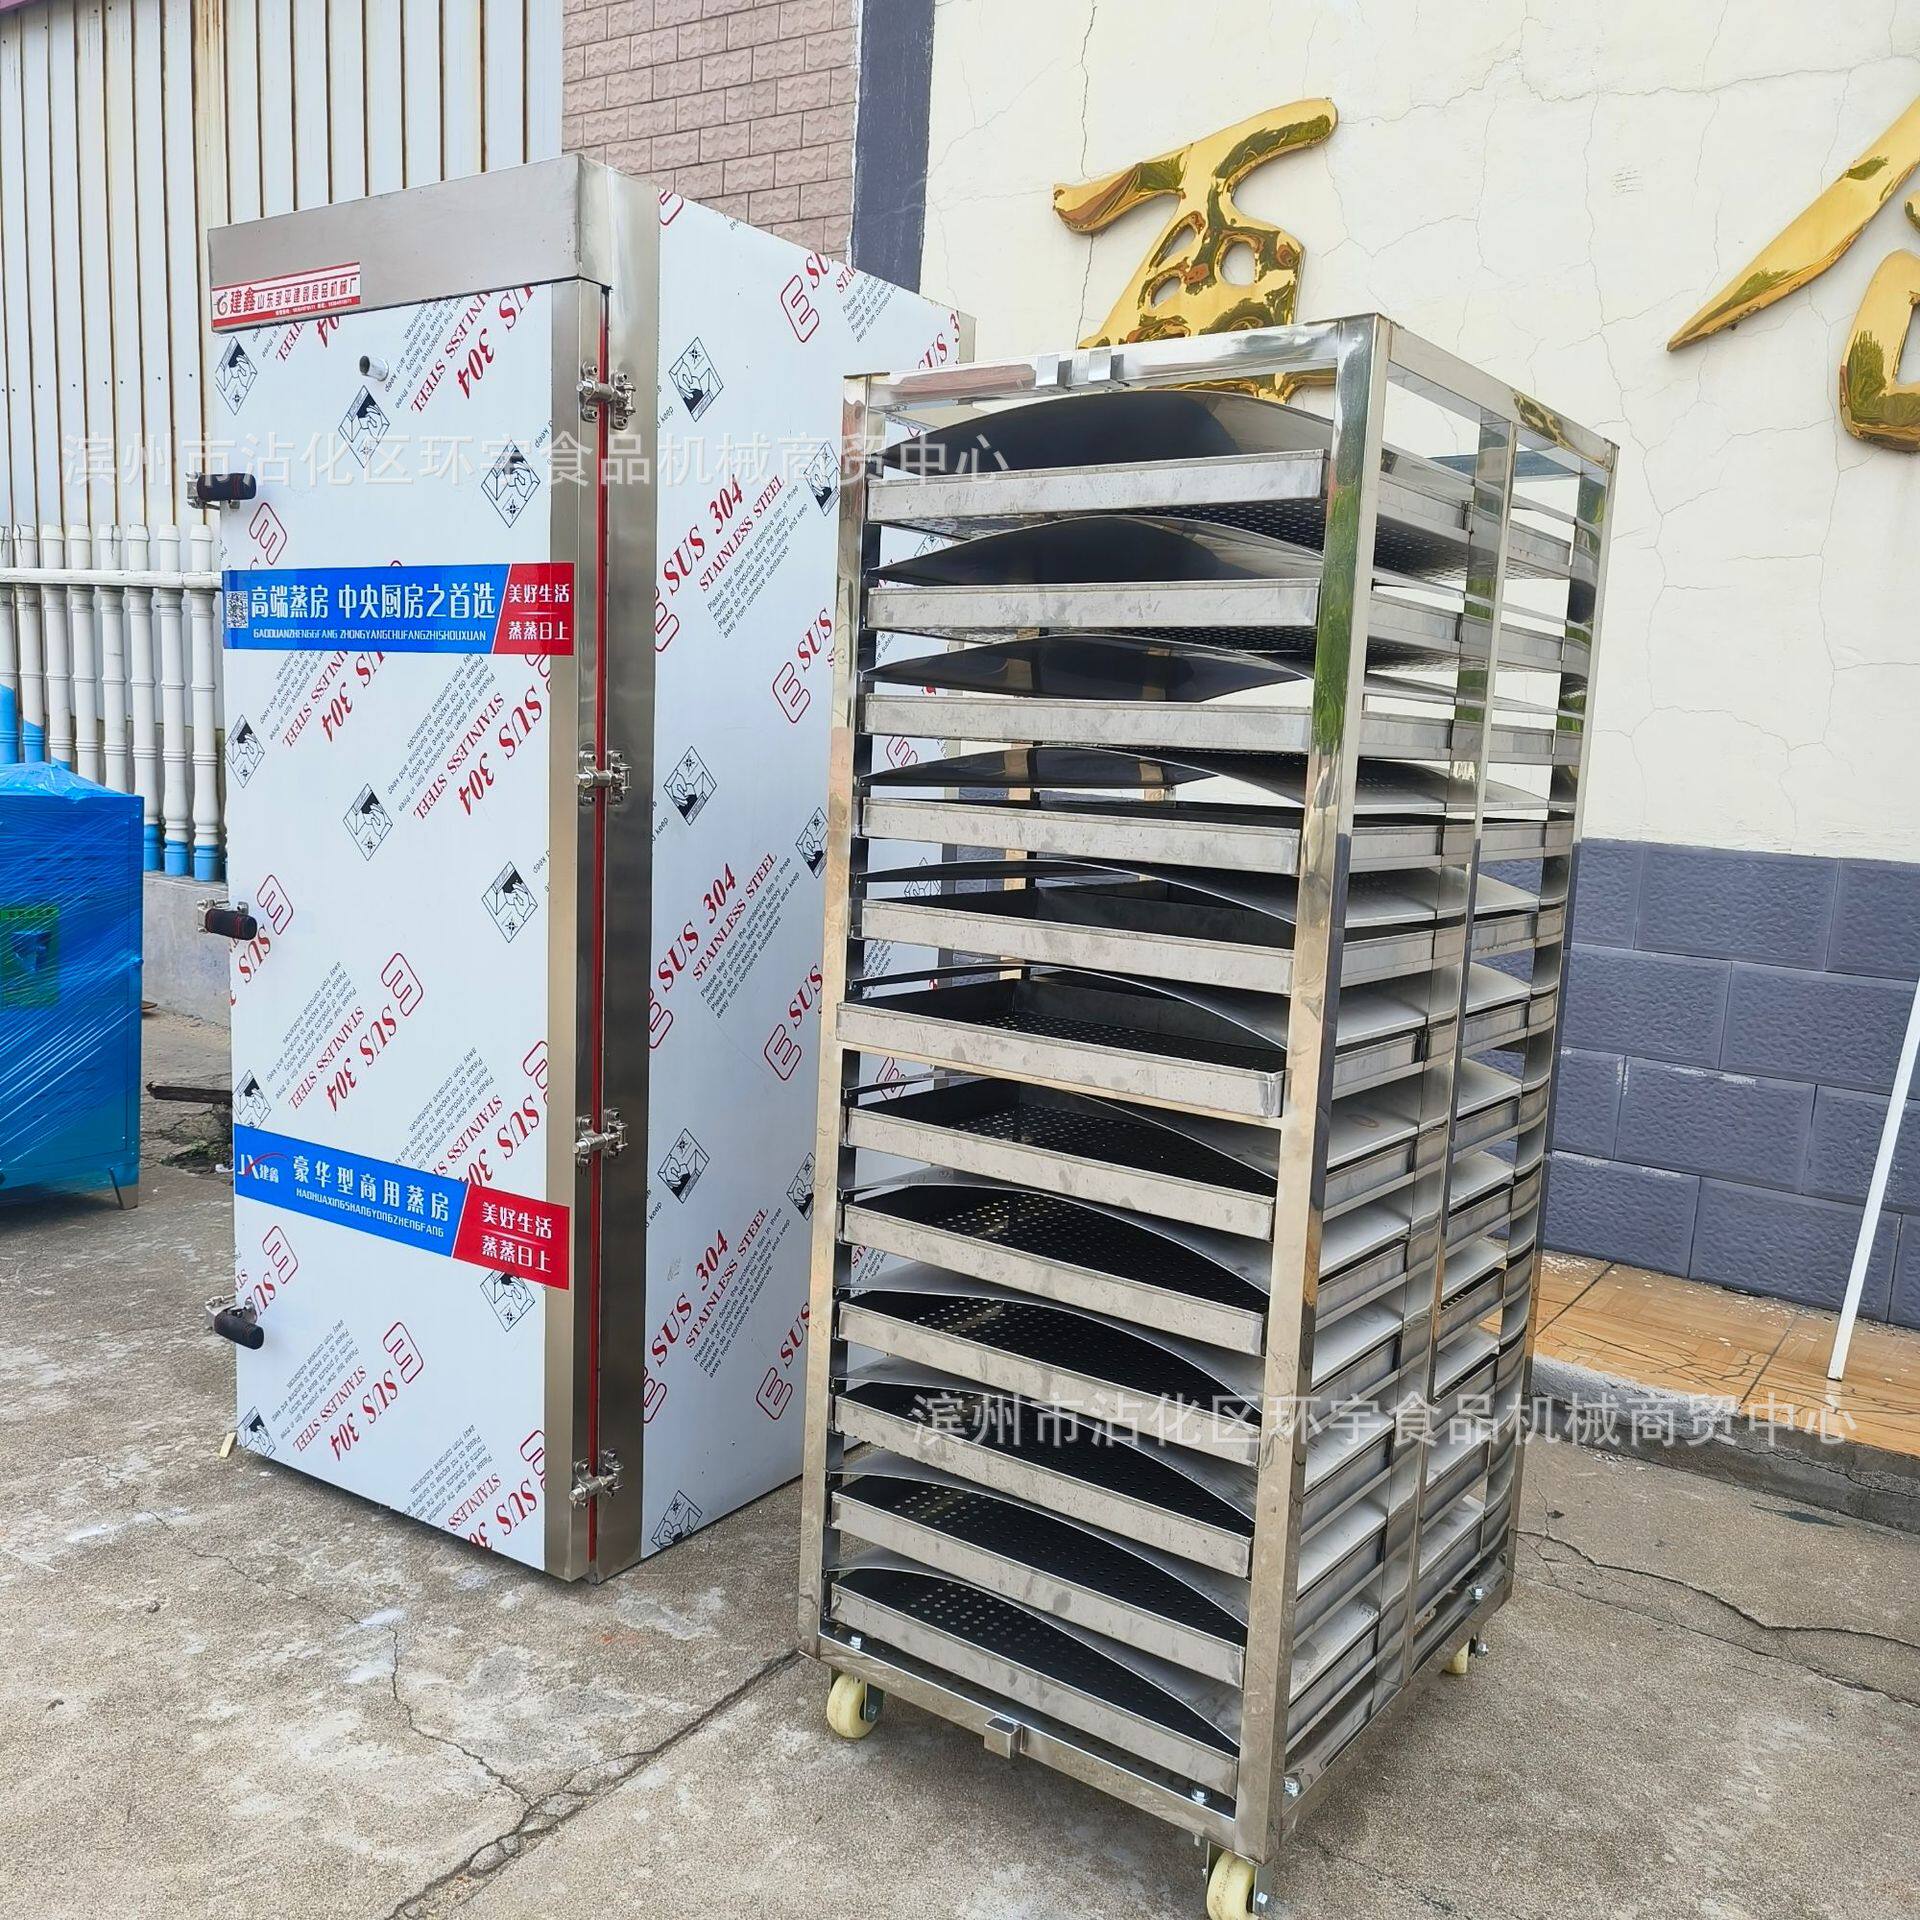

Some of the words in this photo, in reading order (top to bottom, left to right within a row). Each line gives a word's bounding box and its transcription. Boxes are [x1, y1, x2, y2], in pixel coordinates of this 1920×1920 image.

[406, 358, 446, 412] STEEL
[457, 328, 496, 400] 304
[663, 525, 706, 595] SUS
[709, 473, 743, 535] 304
[700, 516, 753, 593] STAINLESS
[753, 474, 784, 519] STEEL
[251, 585, 329, 619] 高端蒸房
[338, 582, 496, 619] 中央厨房之首选
[508, 583, 570, 604] 美好生活
[508, 621, 570, 641] 蒸蒸日上
[282, 702, 312, 747] STEEL
[322, 682, 354, 743] 304
[447, 690, 504, 776] STAINLESS
[499, 686, 543, 760] SUS
[413, 773, 448, 820] STEEL
[459, 752, 496, 816] 304
[658, 920, 699, 992] SUS
[703, 862, 736, 925] 304
[693, 898, 746, 982] STAINLESS
[746, 853, 777, 900] STEEL
[700, 974, 717, 998] Please
[716, 959, 726, 973] tear
[726, 940, 739, 958] down
[737, 928, 746, 939] the
[746, 896, 766, 927] protective
[766, 882, 775, 895] film
[779, 858, 790, 874] three
[710, 988, 727, 1011] Please
[726, 978, 733, 987] do
[734, 964, 742, 977] not
[742, 940, 756, 963] expose
[762, 902, 781, 930] sunshine
[780, 887, 789, 902] and
[788, 872, 799, 888] keep
[706, 980, 723, 1005] months
[723, 969, 728, 978] of
[728, 942, 746, 971] products
[746, 922, 758, 941] leave
[758, 911, 766, 922] the
[716, 1000, 729, 1018] away
[728, 983, 740, 998] from
[739, 953, 758, 982] corrosive
[316, 1006, 364, 1074] STAINLESS
[359, 1004, 397, 1068] SUS
[288, 1070, 317, 1110] STEEL
[326, 1057, 357, 1112] 304
[447, 1094, 502, 1164] STAINLESS
[497, 1093, 541, 1160] SUS
[293, 1155, 449, 1222] 豪华型商用蒸房
[482, 1202, 552, 1239] 美好生活
[481, 1235, 552, 1273] 蒸蒸日上
[686, 1258, 738, 1348] STAINLESS
[738, 1208, 768, 1258] STEEL
[694, 1337, 709, 1362] Please
[709, 1320, 718, 1335] tear
[719, 1299, 731, 1318] down
[730, 1286, 738, 1297] the
[738, 1250, 758, 1284] protective
[757, 1236, 766, 1248] film
[770, 1208, 782, 1226] three
[651, 1292, 692, 1368] SUS
[696, 1229, 728, 1291] 304
[700, 1341, 715, 1367] months
[715, 1329, 720, 1338] of
[720, 1299, 738, 1330] products
[738, 1278, 750, 1297] leave
[750, 1264, 758, 1276] the
[704, 1348, 719, 1372] Please
[718, 1336, 726, 1346] do
[726, 1321, 734, 1334] not
[734, 1295, 748, 1320] expose
[754, 1253, 772, 1283] sunshine
[772, 1236, 780, 1251] and
[779, 1219, 790, 1236] keep
[709, 1359, 721, 1378] away
[720, 1340, 731, 1356] from
[731, 1306, 750, 1338] corrosive
[320, 1366, 366, 1422] STAINLESS
[362, 1370, 399, 1425] SUS
[292, 1418, 321, 1452] STEEL
[330, 1417, 360, 1462] 304
[448, 1473, 501, 1537] STAINLESS
[495, 1478, 539, 1536] SUS
